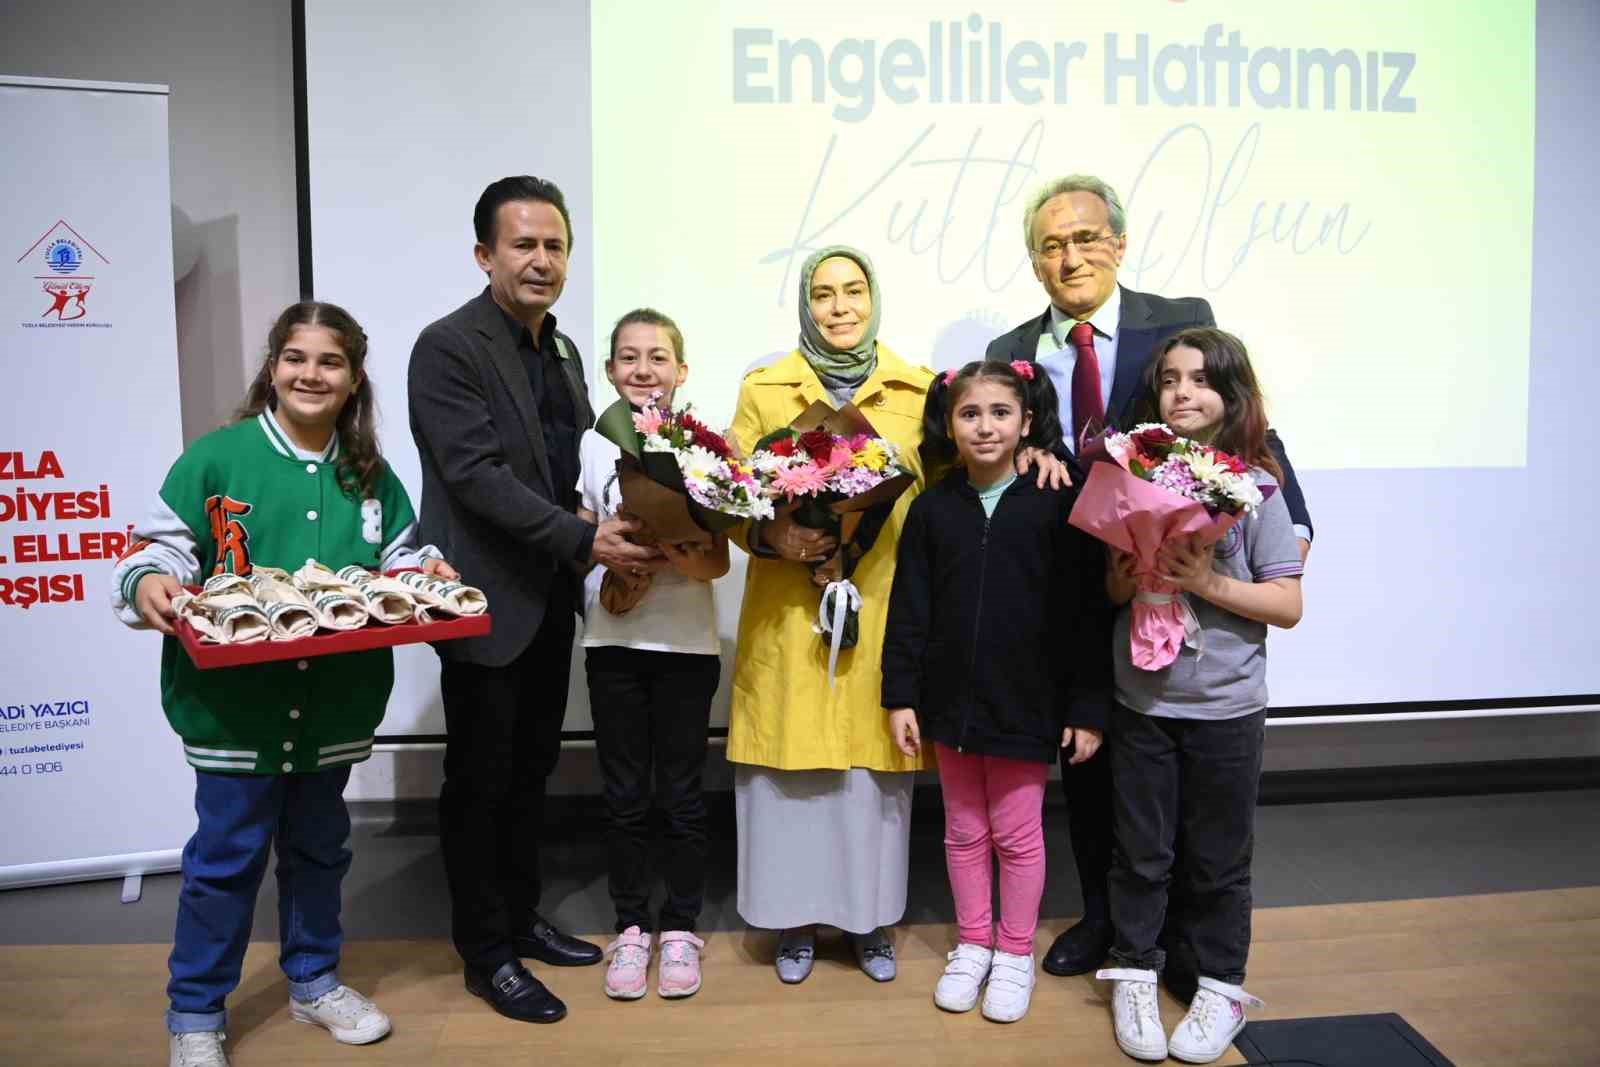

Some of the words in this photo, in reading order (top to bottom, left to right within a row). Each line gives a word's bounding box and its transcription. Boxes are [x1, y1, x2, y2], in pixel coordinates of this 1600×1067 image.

[733, 12, 1087, 123] Engelliler
[1104, 23, 1417, 113] Haftamız
[758, 116, 1100, 308] Kutl
[30, 700, 89, 717] YAZICI
[9, 741, 84, 755] tuzlabelediyesi
[36, 761, 63, 773] 906
